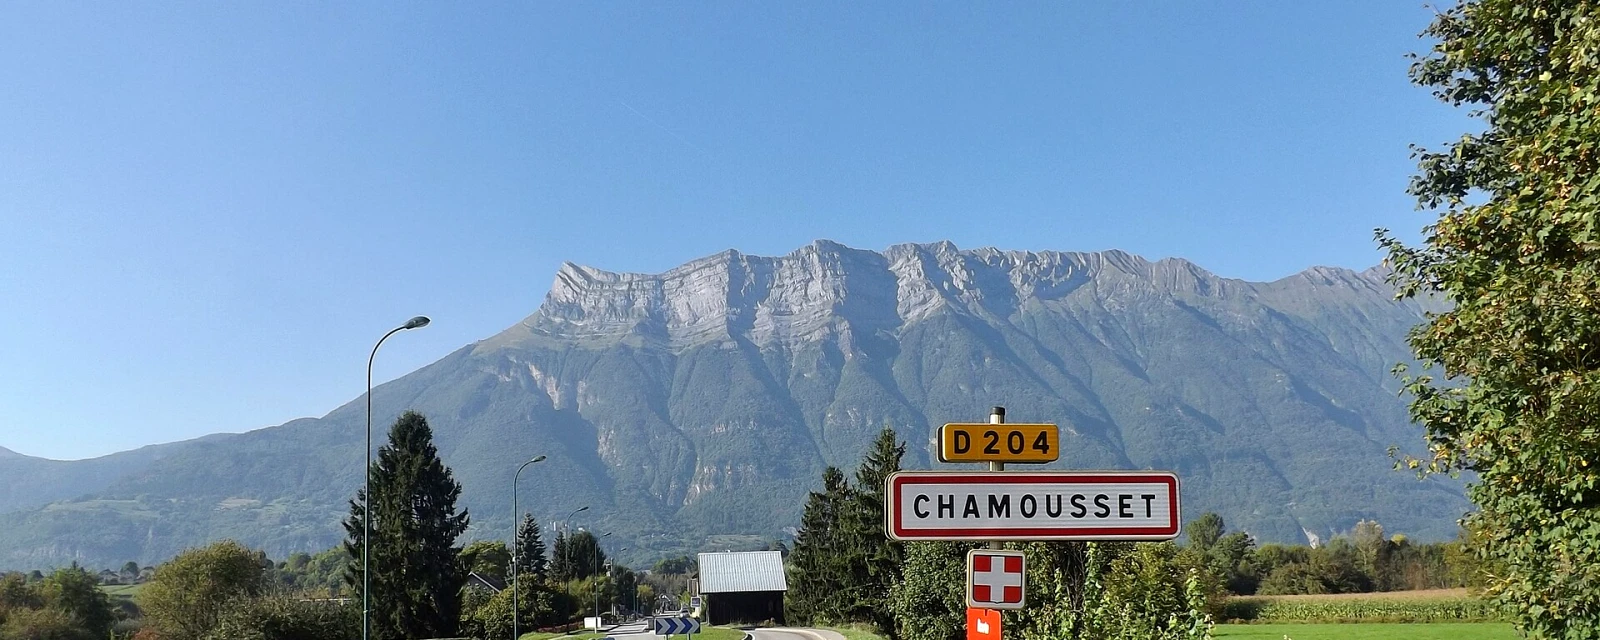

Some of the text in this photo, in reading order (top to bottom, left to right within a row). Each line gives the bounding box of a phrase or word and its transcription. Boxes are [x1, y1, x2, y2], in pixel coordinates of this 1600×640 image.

[953, 430, 1050, 455] D 204
[913, 493, 1156, 519] CHAMOUSSET
